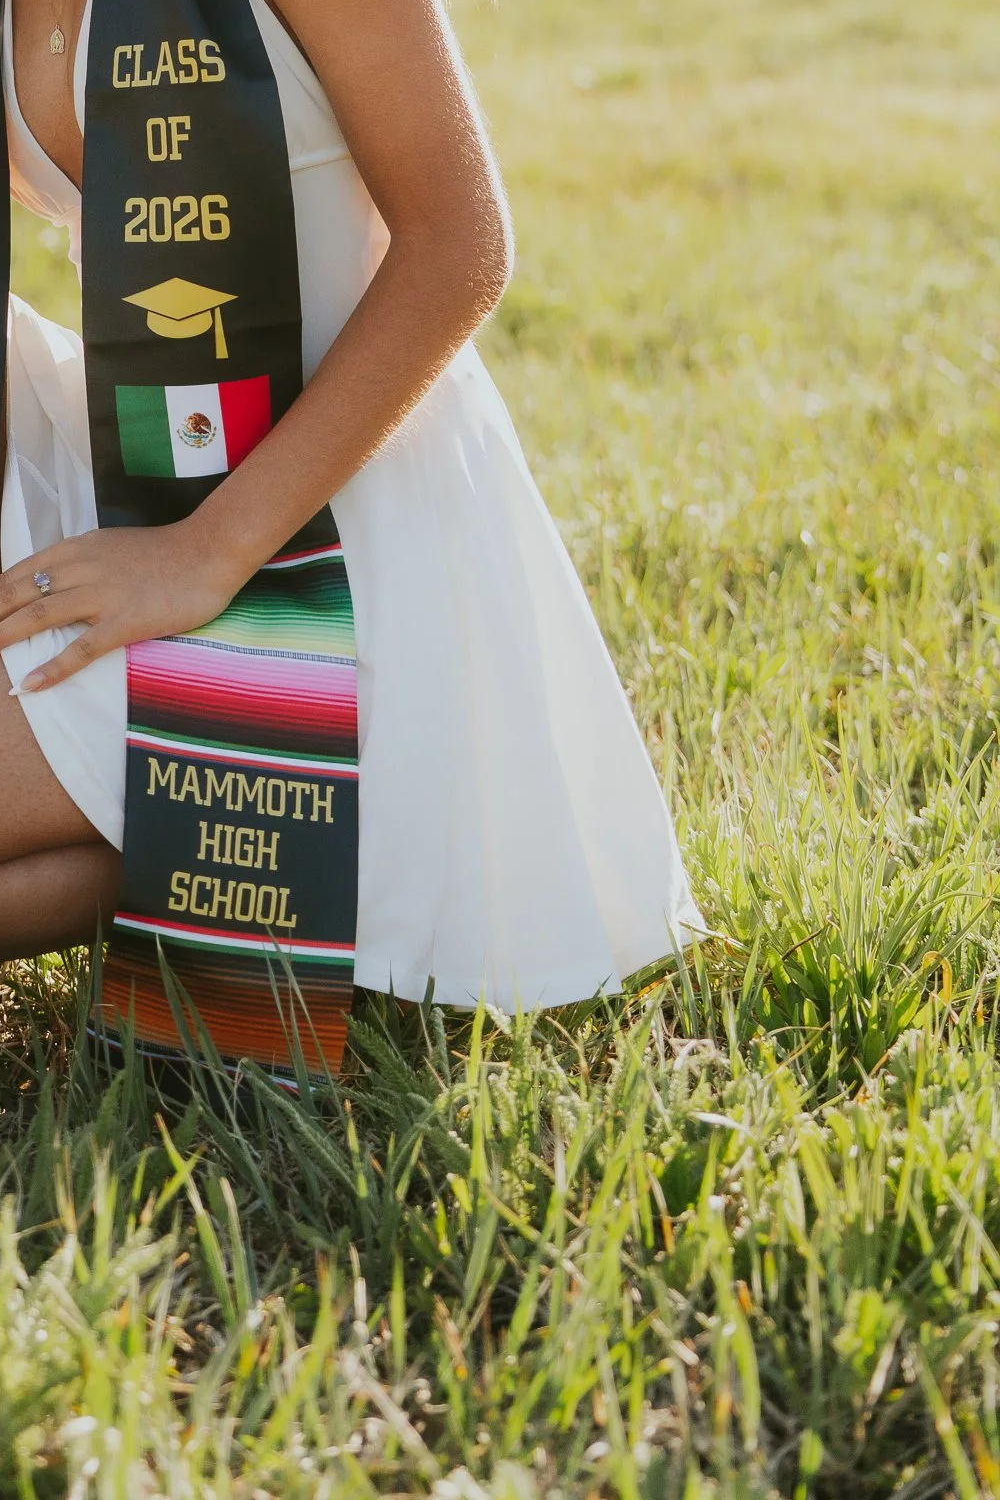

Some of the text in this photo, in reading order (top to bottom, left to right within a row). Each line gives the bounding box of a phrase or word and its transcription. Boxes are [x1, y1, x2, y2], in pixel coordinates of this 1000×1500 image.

[112, 38, 226, 89] CLASS
[146, 115, 191, 162] OF
[124, 194, 231, 243] 2026
[147, 757, 334, 823] MAMMOTH
[197, 821, 280, 871] HIGH
[168, 871, 297, 928] SCHOOL
